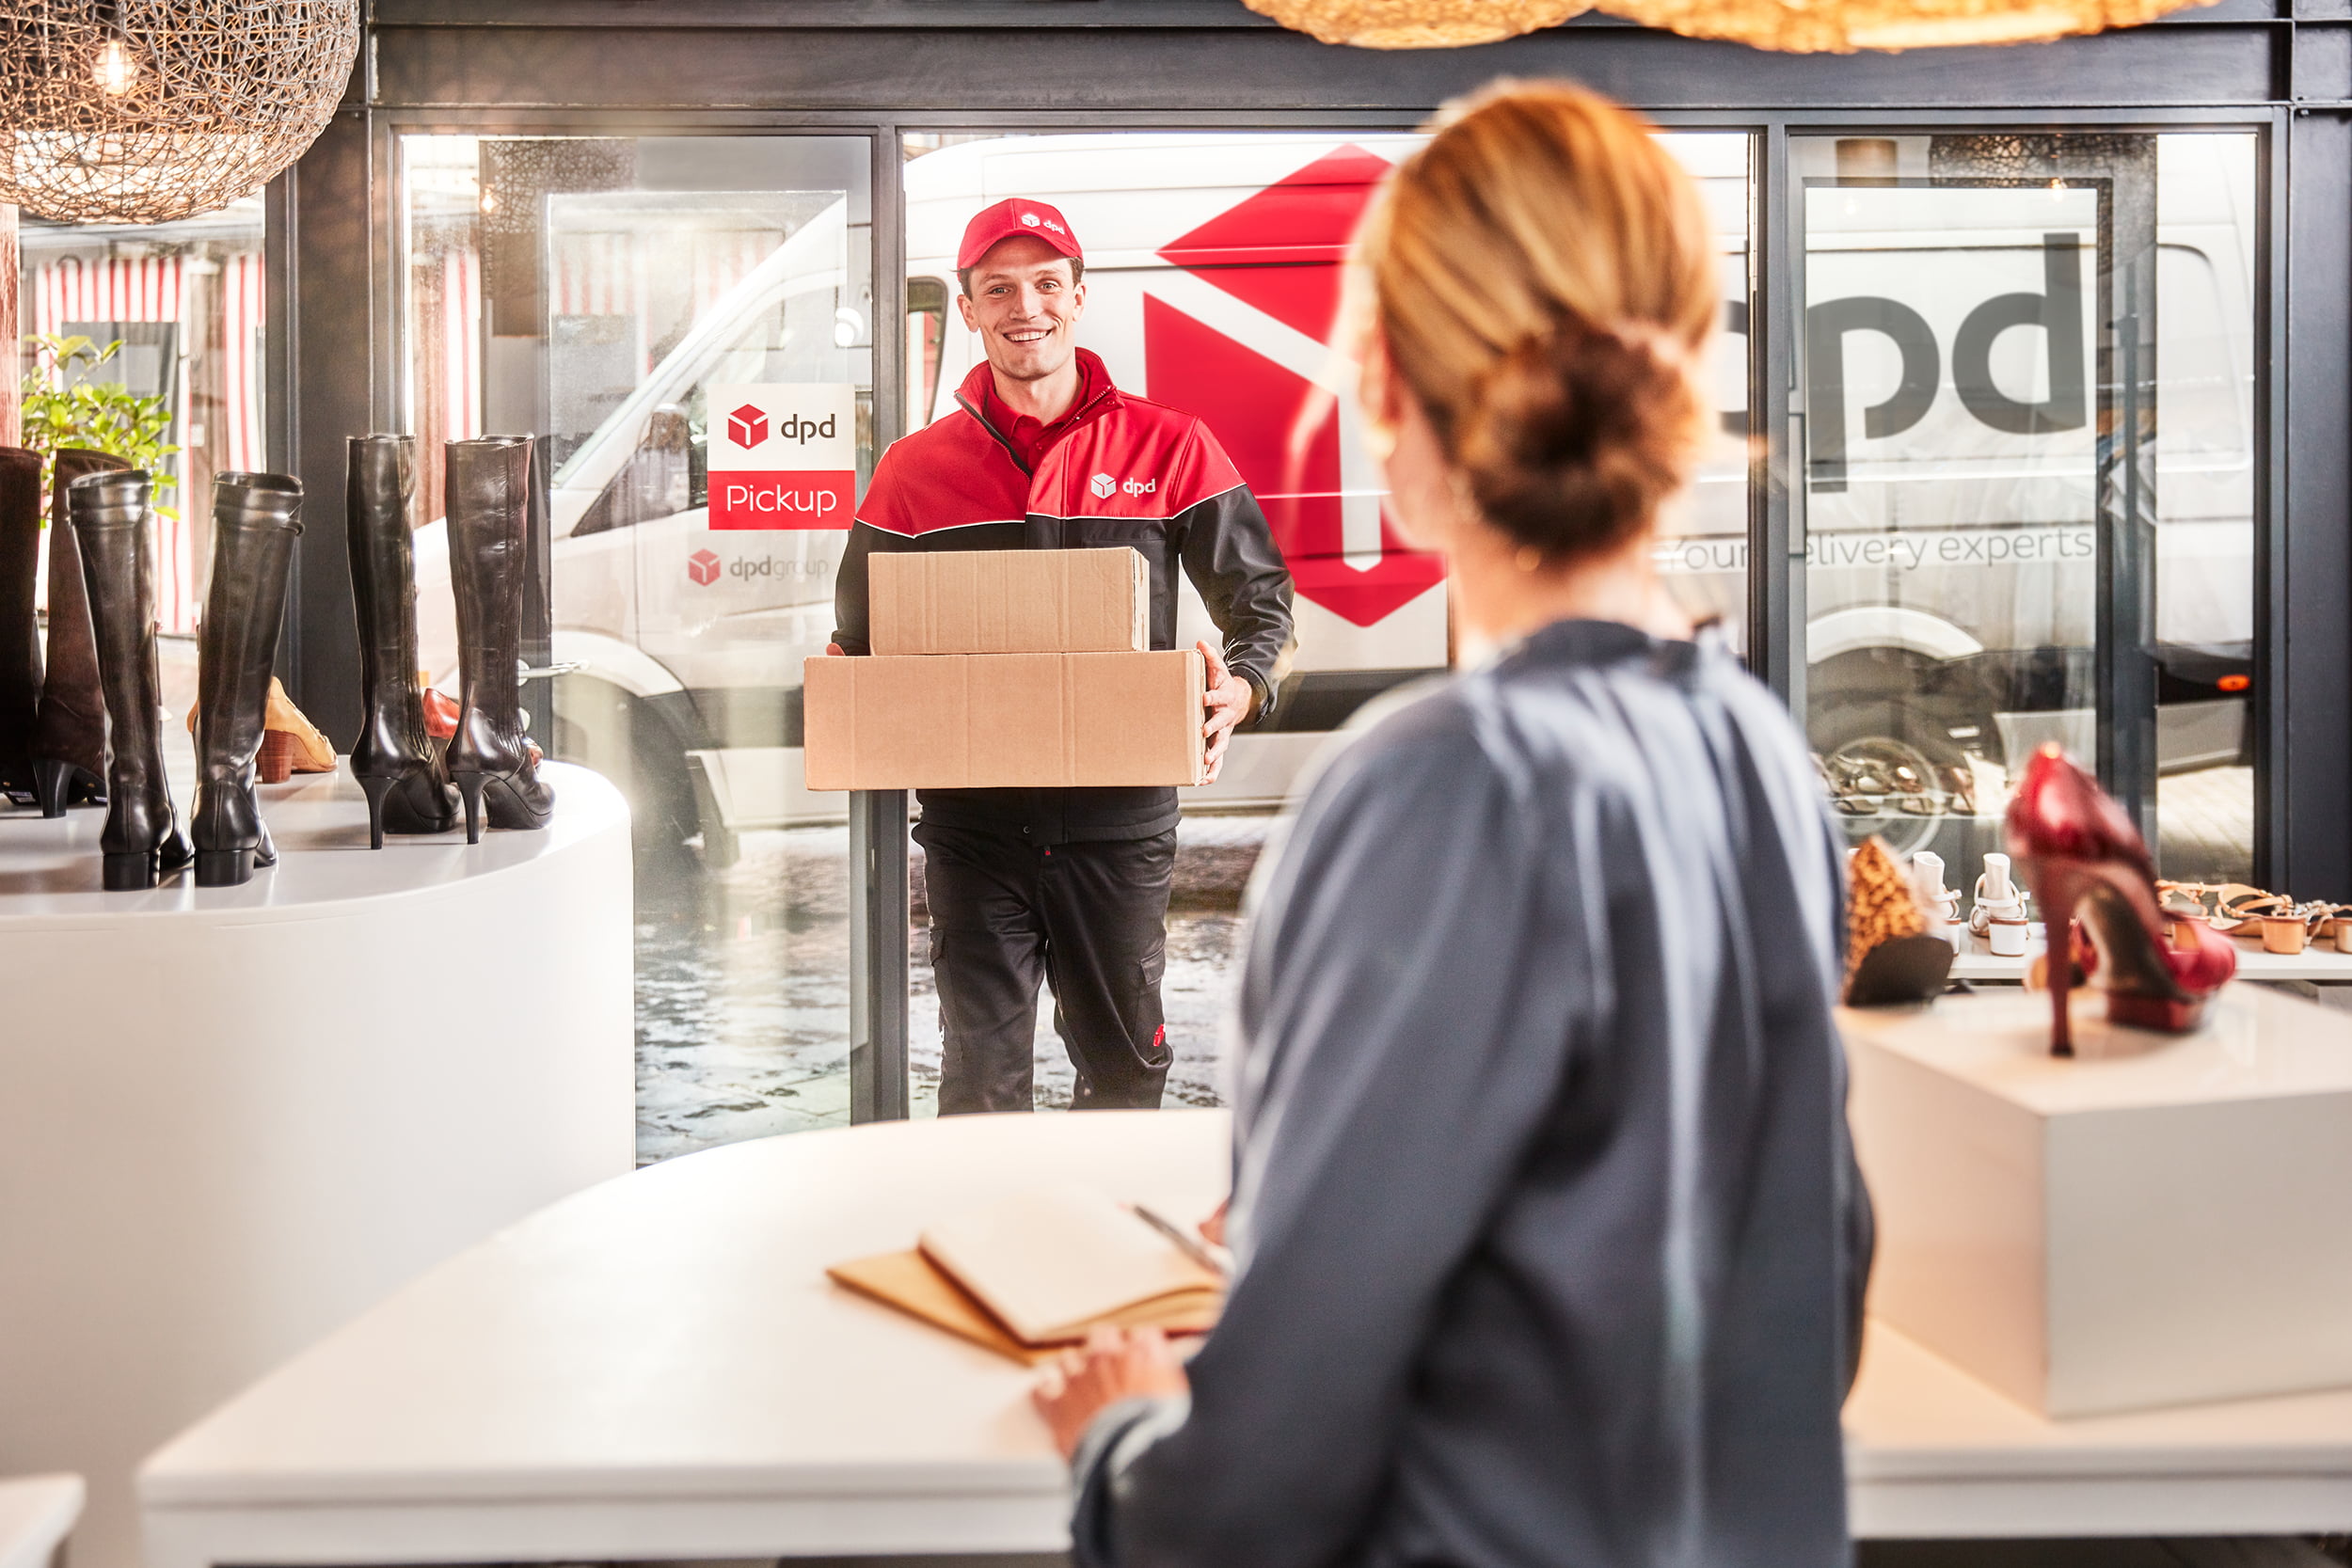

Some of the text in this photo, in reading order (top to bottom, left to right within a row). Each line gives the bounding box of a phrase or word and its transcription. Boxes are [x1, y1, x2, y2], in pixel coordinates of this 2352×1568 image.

[1043, 220, 1065, 234] dpd
[1718, 232, 2087, 494] pd
[781, 413, 835, 445] dpd
[727, 484, 837, 517] Pickup
[1122, 477, 1156, 498] dpd
[1806, 532, 1927, 571] livery
[1938, 527, 2092, 567] experts
[730, 555, 829, 581] dpdgroup
